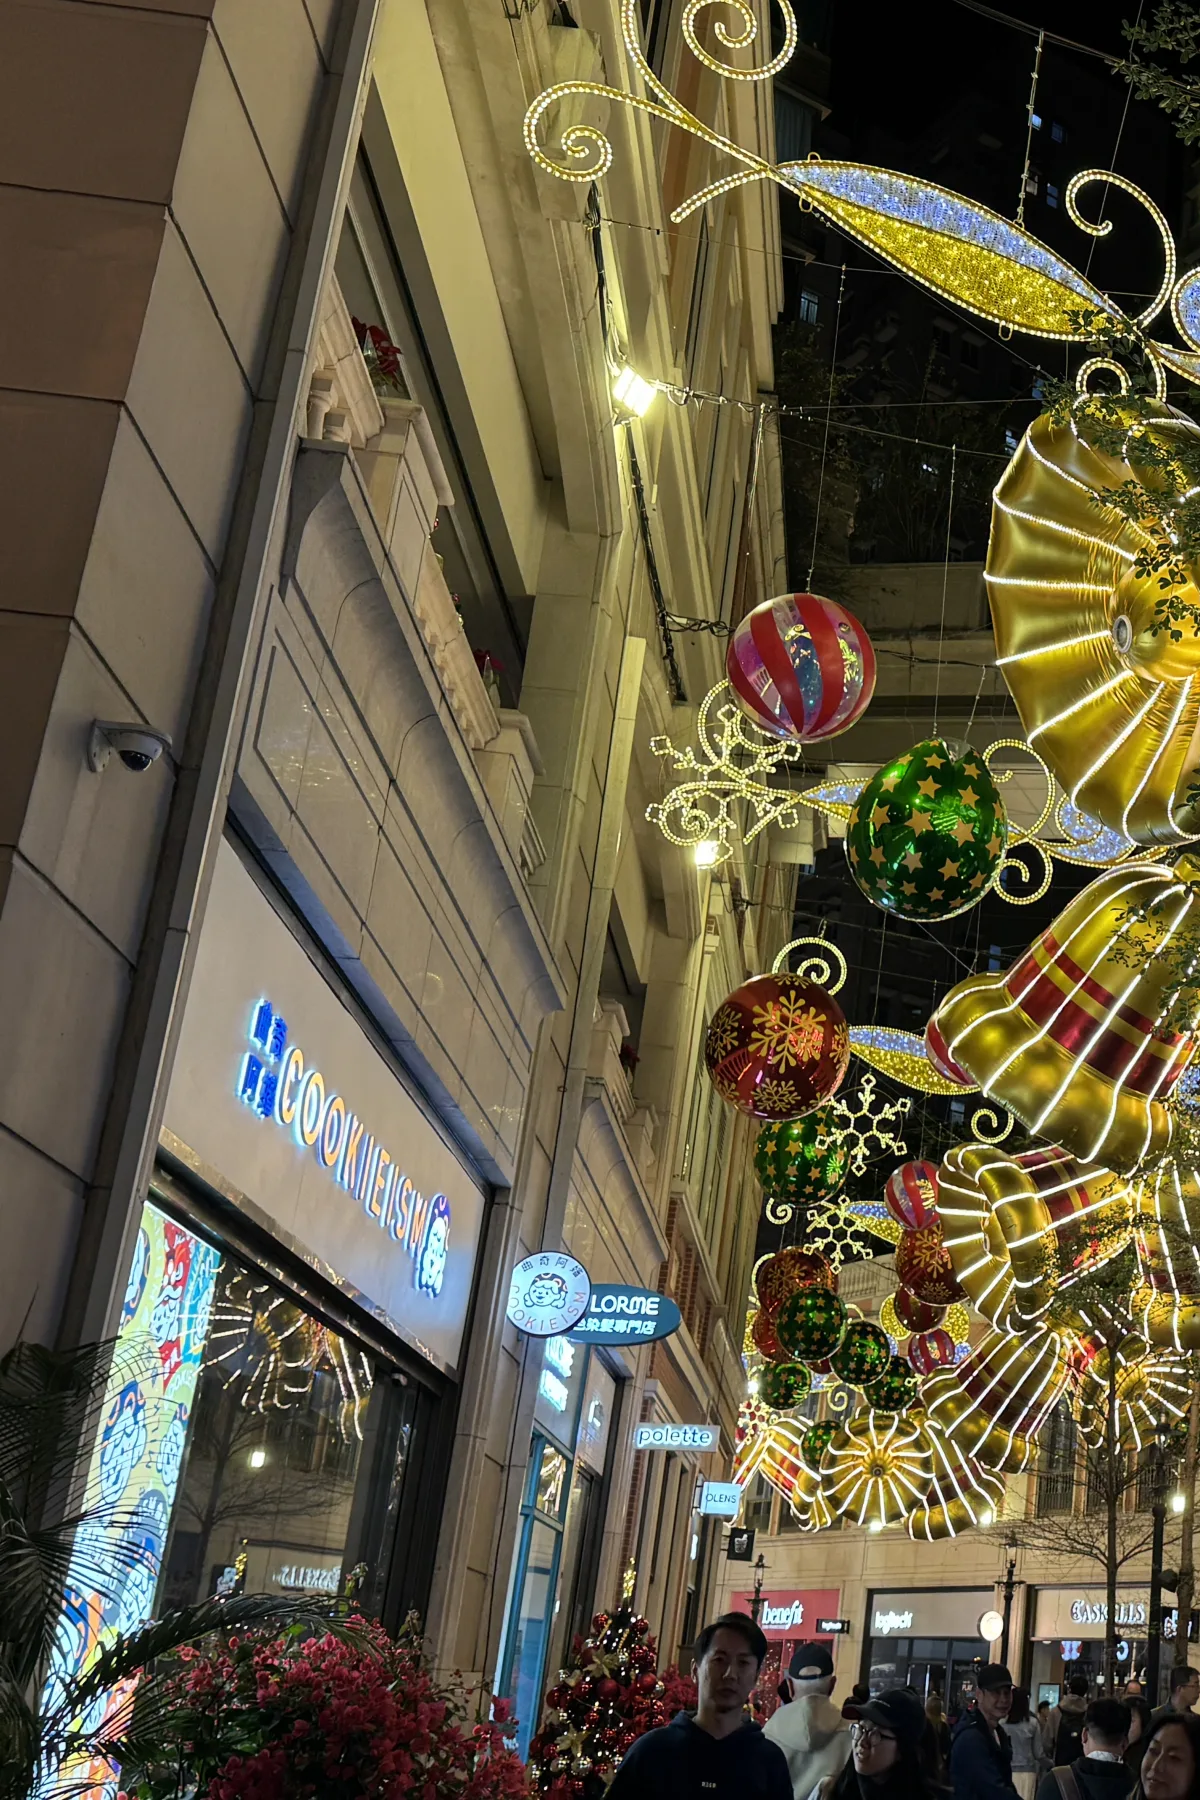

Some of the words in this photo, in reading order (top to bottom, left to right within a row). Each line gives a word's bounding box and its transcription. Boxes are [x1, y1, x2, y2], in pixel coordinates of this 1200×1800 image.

[275, 1047, 428, 1262] COOKIEISM
[639, 1428, 710, 1444] polette
[705, 1493, 737, 1503] OLENS
[762, 1600, 804, 1630] benefit
